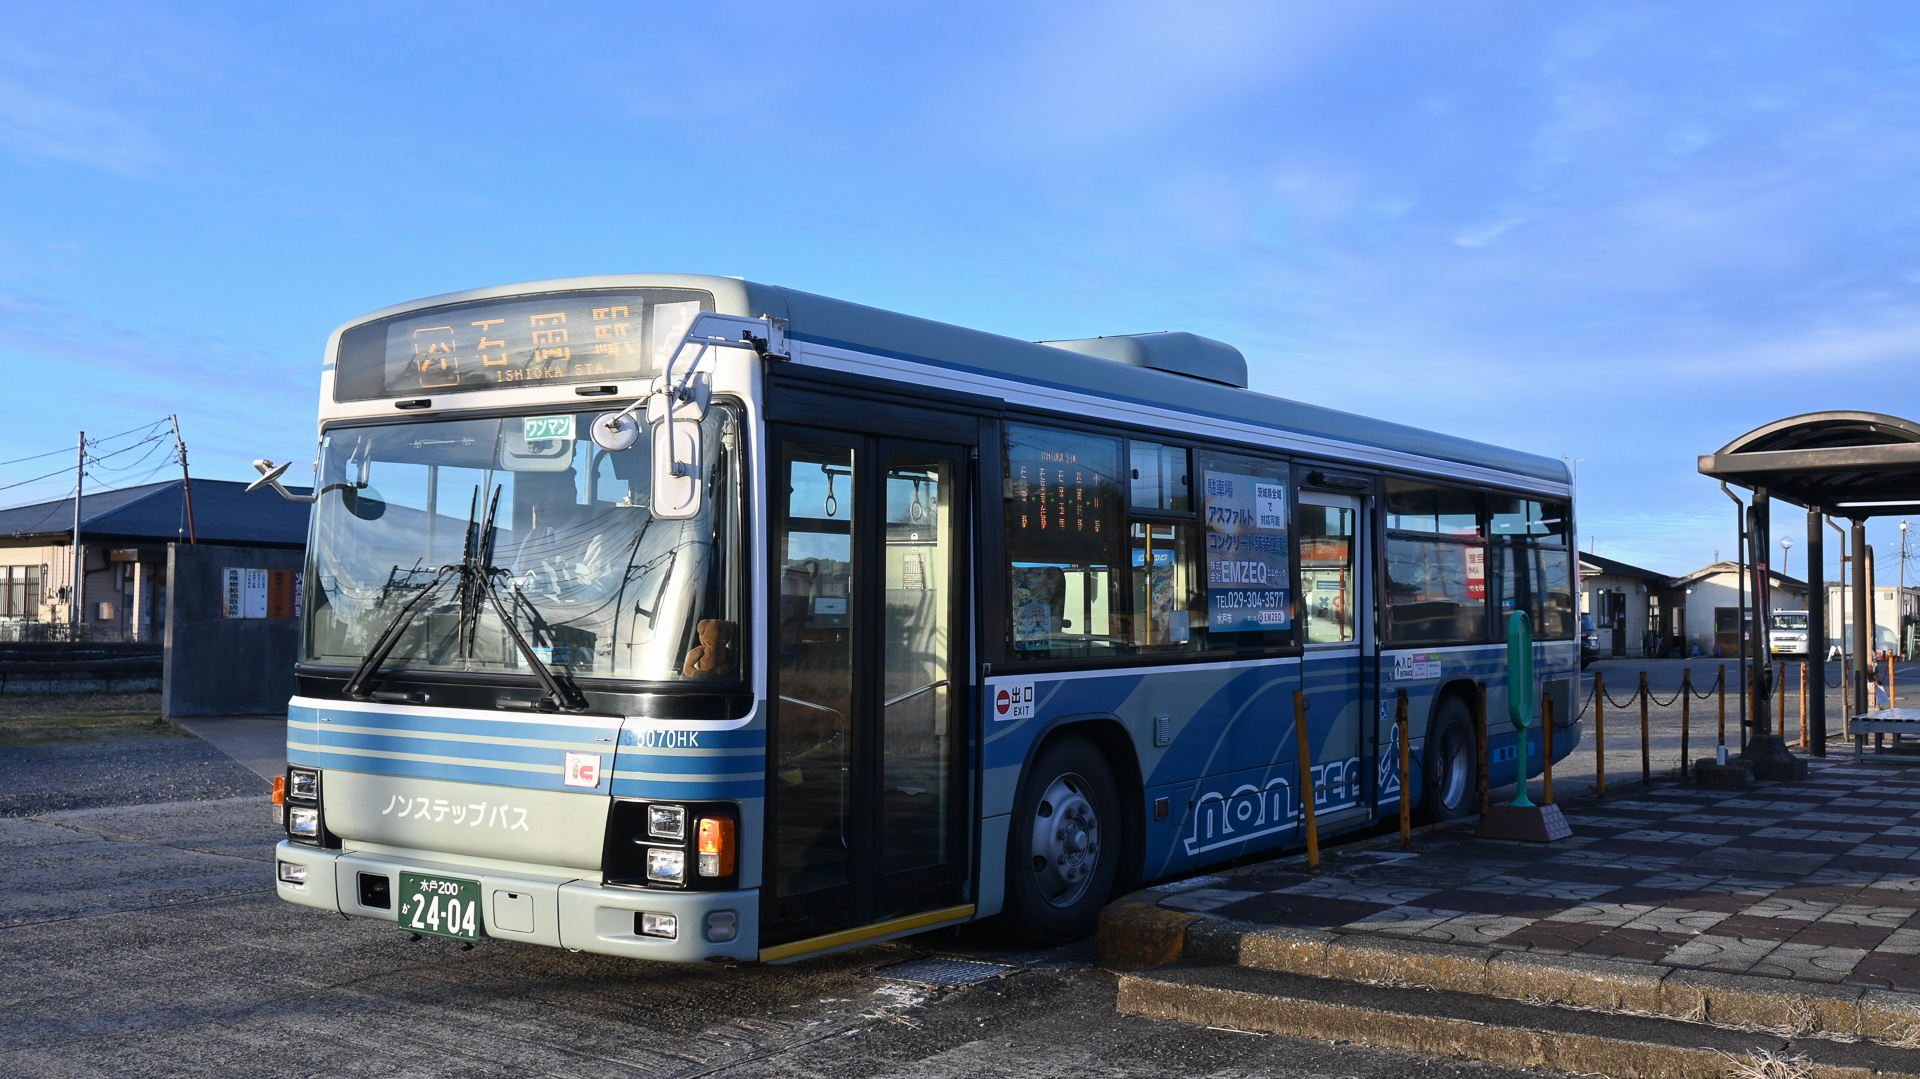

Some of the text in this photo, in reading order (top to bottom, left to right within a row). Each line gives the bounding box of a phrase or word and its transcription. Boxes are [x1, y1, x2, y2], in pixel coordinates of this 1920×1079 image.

[496, 365, 563, 383] ISHIOKA
[526, 418, 569, 437] ワンマン
[1208, 478, 1233, 498] 駐車場
[1209, 506, 1254, 525] アスファルト
[1267, 502, 1273, 512] で
[1260, 514, 1280, 527] 対応可能
[1209, 533, 1285, 553] コンクリート舗装工事
[1222, 561, 1267, 584] EMZEQ
[1217, 613, 1233, 624] 水戸市
[1264, 612, 1282, 623] EMZEQ
[1011, 686, 1033, 703] 出口
[1013, 706, 1030, 716] EXIT
[381, 794, 529, 832] ノンステップバス
[402, 893, 476, 937] か 24-04
